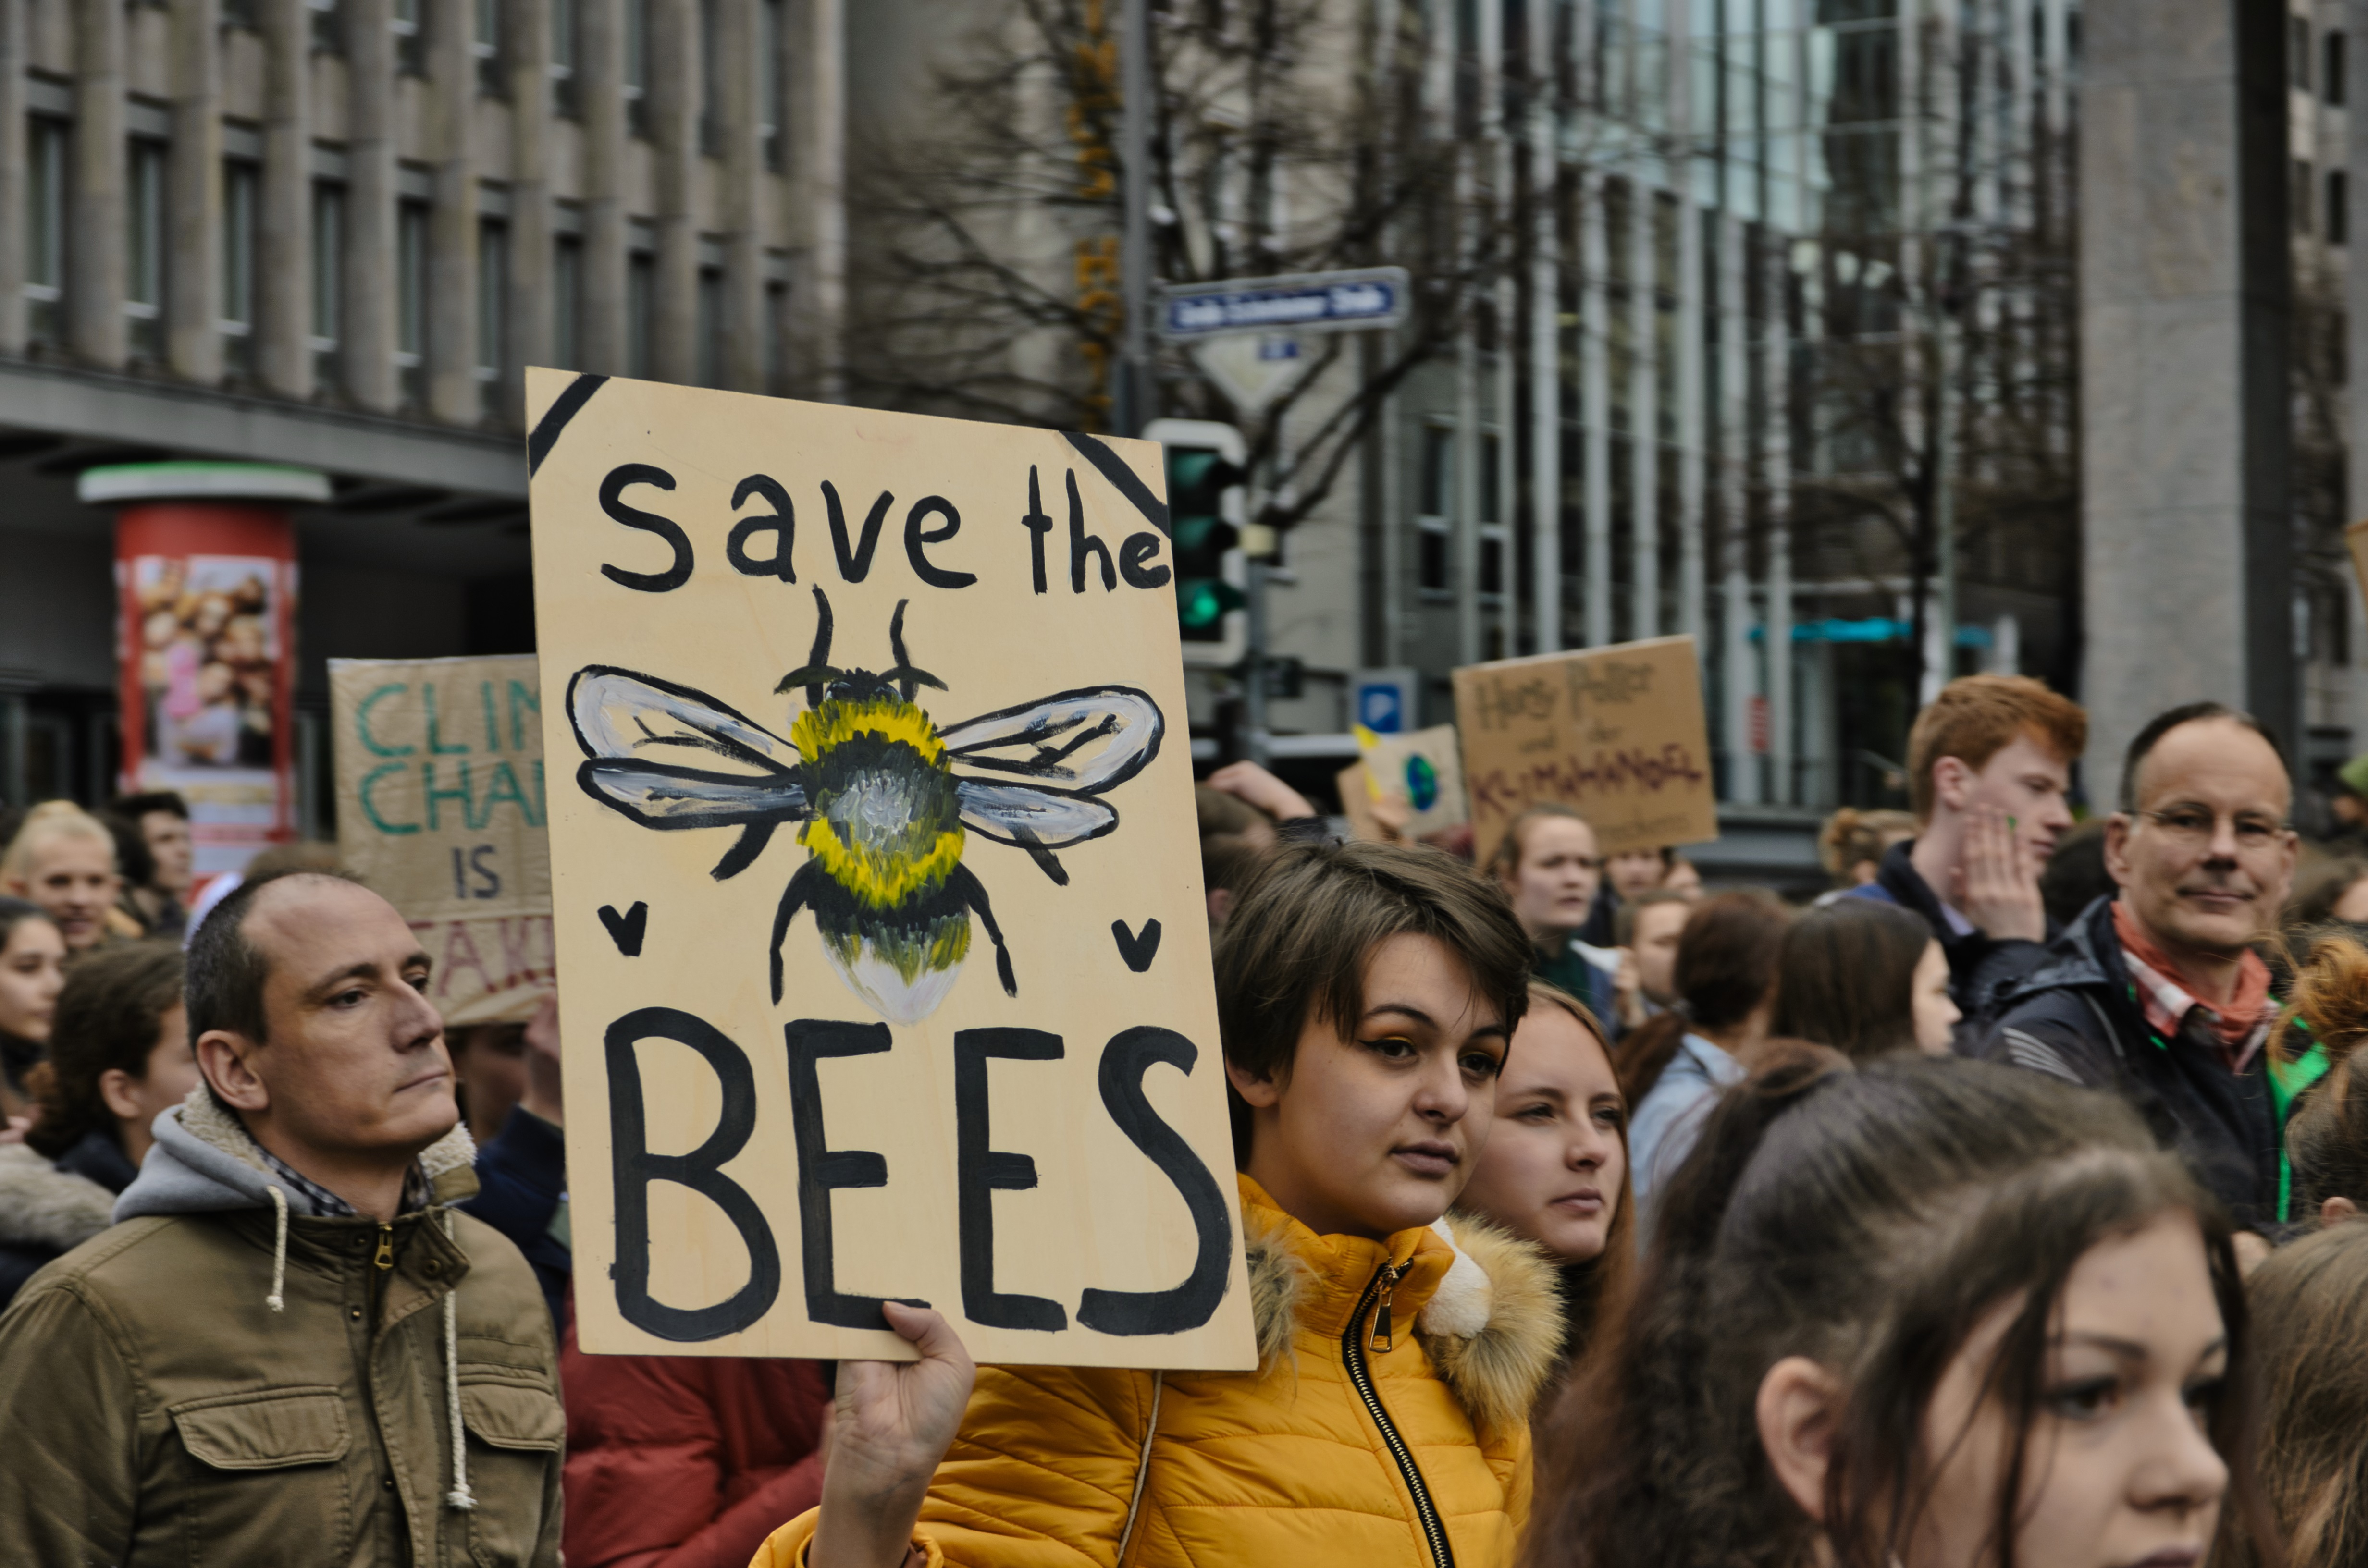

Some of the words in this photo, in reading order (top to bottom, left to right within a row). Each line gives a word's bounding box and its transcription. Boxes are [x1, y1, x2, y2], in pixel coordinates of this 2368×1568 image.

[1021, 464, 1171, 594] the
[452, 844, 502, 899] IS
[604, 1006, 1233, 1342] BEES
